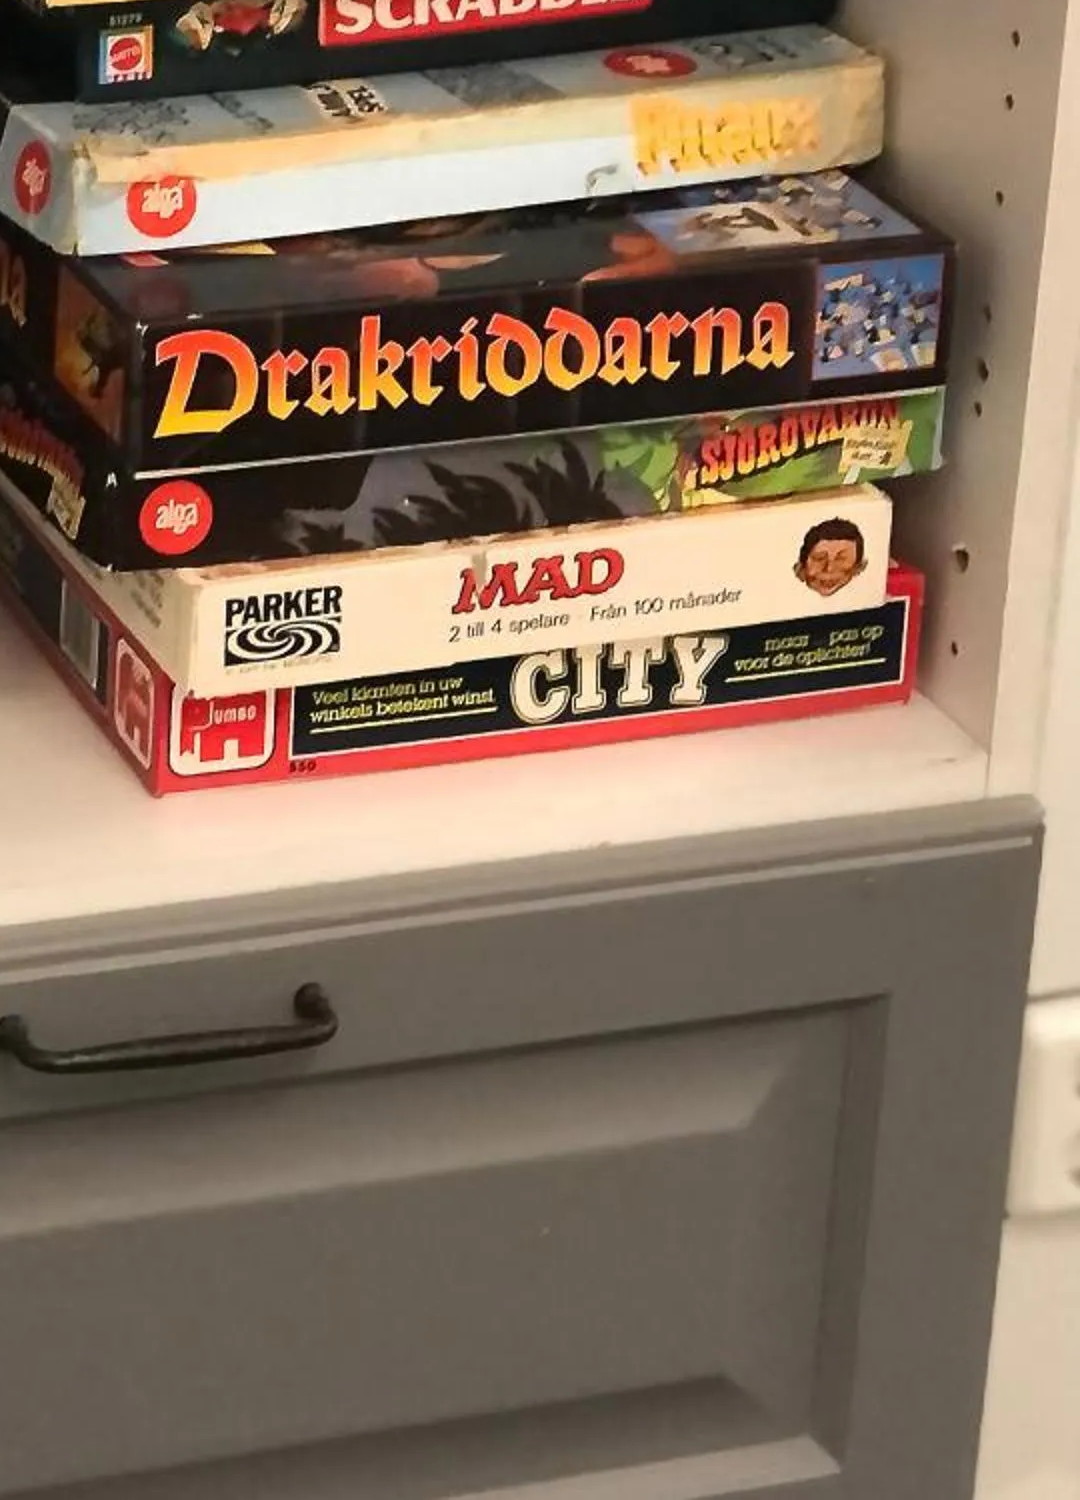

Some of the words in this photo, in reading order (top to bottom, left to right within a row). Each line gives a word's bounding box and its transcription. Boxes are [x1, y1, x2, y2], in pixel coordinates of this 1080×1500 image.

[152, 300, 795, 440] Drakriddarna
[156, 499, 202, 535] alga
[452, 547, 625, 616] MAD
[225, 585, 343, 629] PARKER
[448, 626, 461, 643] 2
[467, 619, 485, 638] till
[490, 617, 502, 634] 4
[508, 613, 571, 635] spelare
[589, 604, 628, 621] Från
[634, 598, 664, 615] 100
[669, 587, 744, 611] månader
[861, 624, 885, 641] op
[509, 631, 731, 725] CITY
[733, 656, 769, 671] voor
[772, 653, 794, 667] de
[420, 679, 436, 694] in
[439, 676, 463, 690] uw
[309, 703, 373, 723] winkels
[376, 694, 449, 716] betekent
